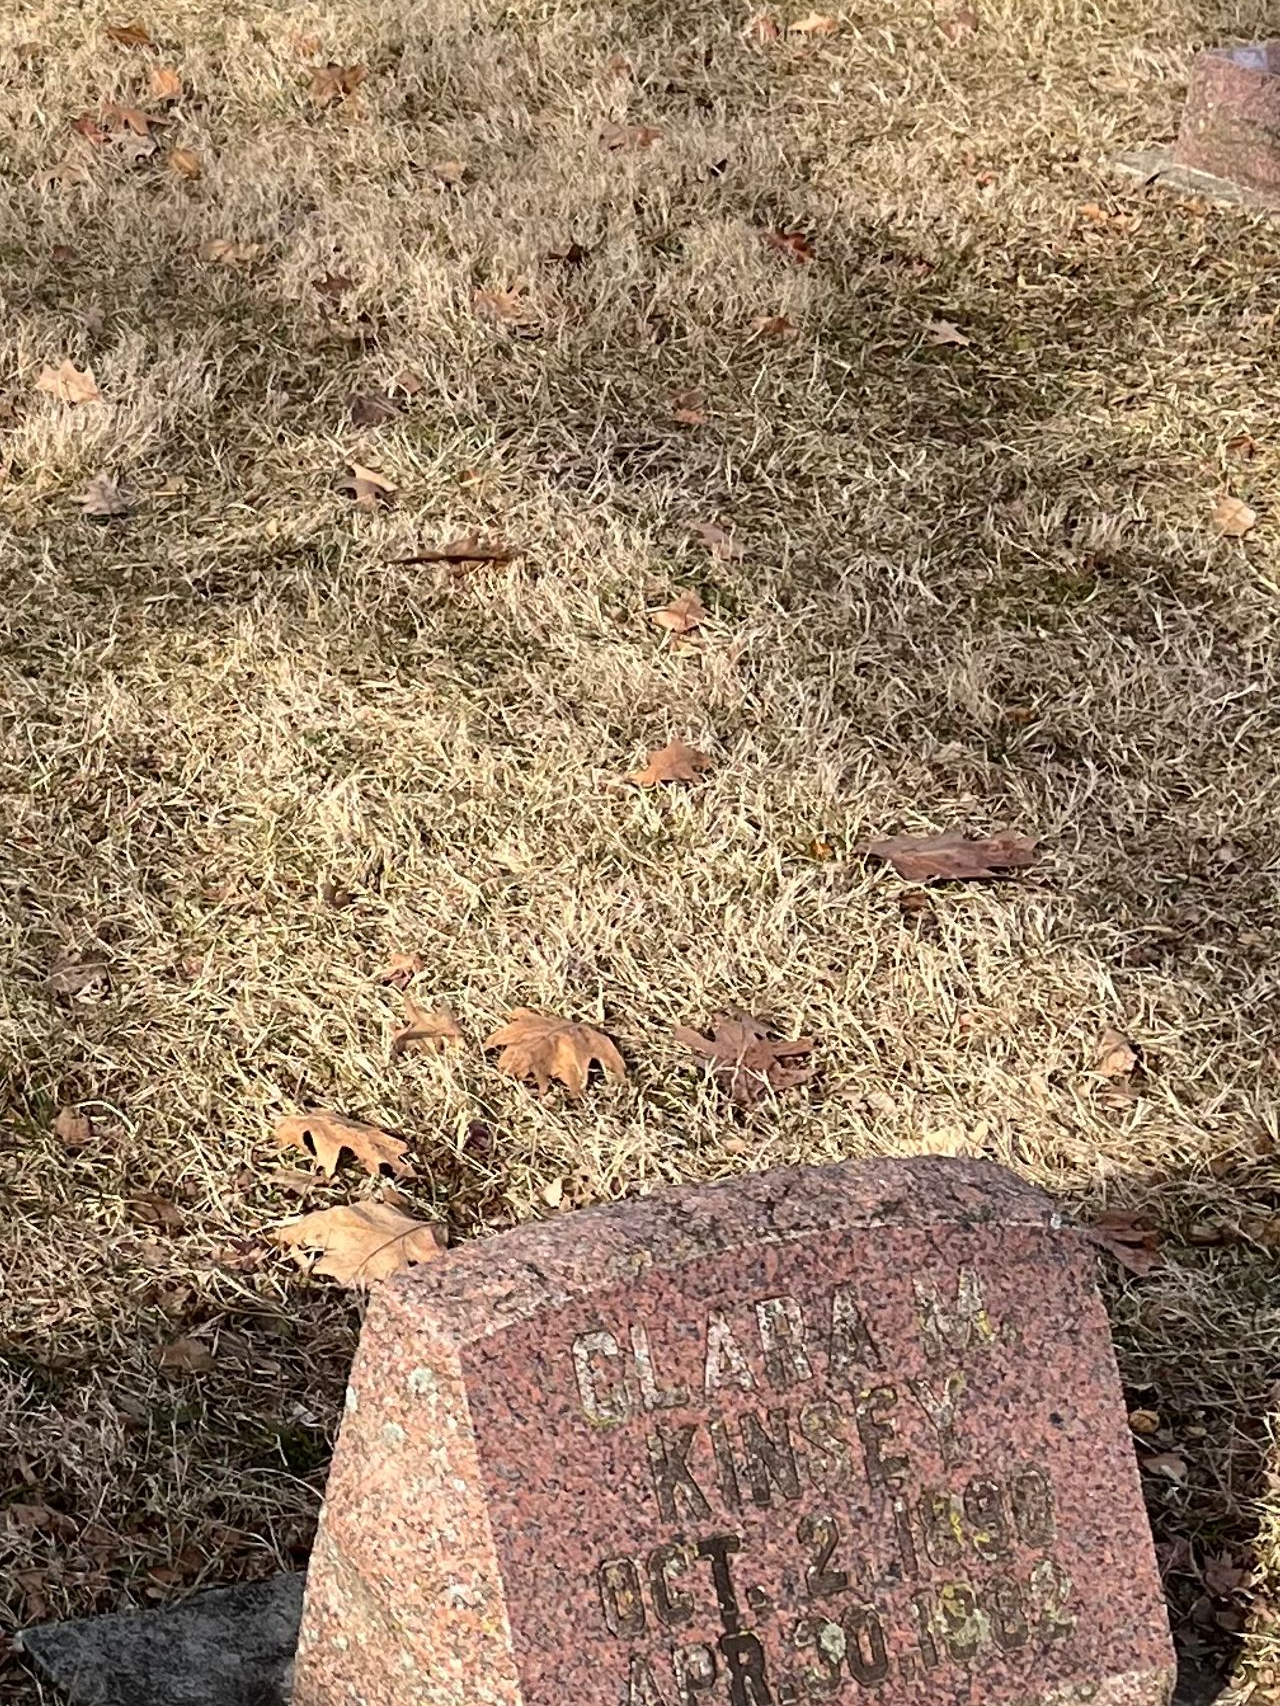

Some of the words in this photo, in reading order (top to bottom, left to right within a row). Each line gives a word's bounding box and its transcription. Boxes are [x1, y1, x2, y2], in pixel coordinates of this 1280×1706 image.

[572, 1281, 886, 1427] CLARA
[645, 1373, 964, 1527] KINSEY
[597, 1529, 774, 1641] OCT.
